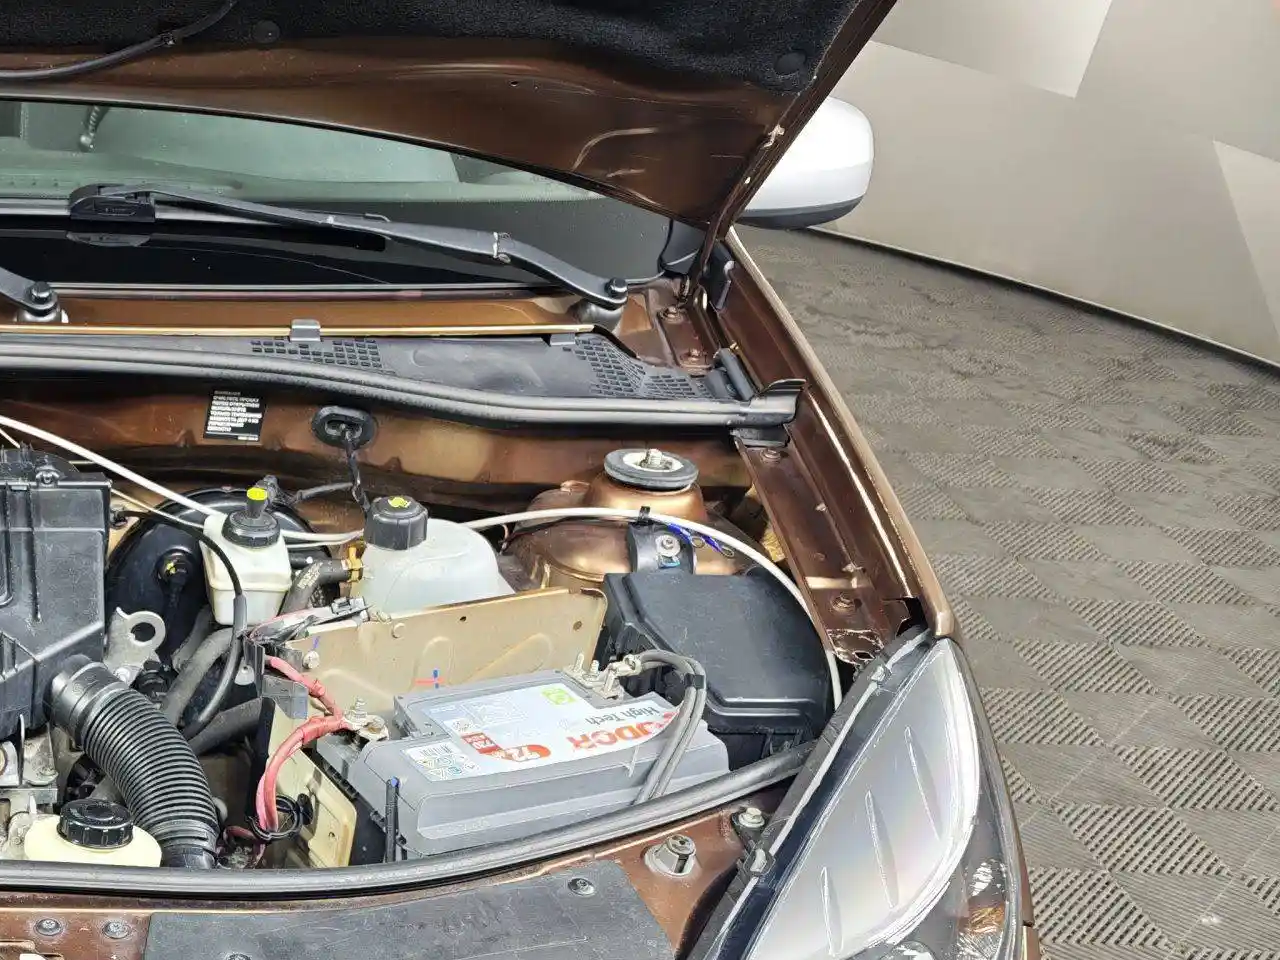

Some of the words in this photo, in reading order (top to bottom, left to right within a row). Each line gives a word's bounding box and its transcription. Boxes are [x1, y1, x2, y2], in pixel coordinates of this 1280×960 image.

[585, 711, 625, 726] Tech
[620, 706, 660, 719] High
[566, 711, 679, 749] UDOR
